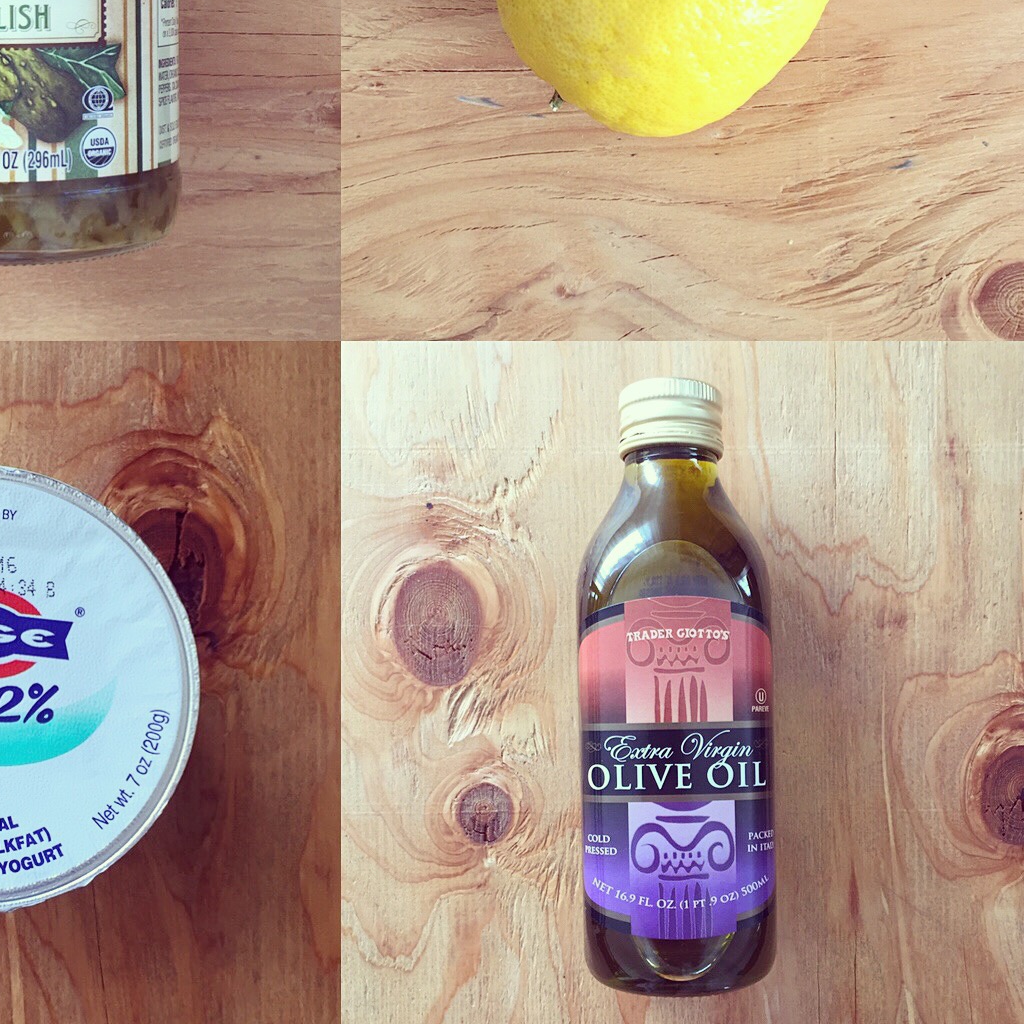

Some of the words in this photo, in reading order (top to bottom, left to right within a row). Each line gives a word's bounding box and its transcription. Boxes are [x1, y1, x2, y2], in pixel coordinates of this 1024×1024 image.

[90, 137, 109, 147] USDA
[2, 150, 19, 169] OZ
[23, 148, 73, 172] (296mL)
[1, 508, 18, 521] BY
[626, 628, 673, 643] TRADER
[676, 627, 731, 642] GIOTTO'S
[751, 705, 769, 713] PAREVE
[141, 709, 172, 756] (200g)
[604, 735, 674, 762] Extra
[680, 729, 754, 768] Virgin
[137, 758, 154, 777] oz
[587, 763, 692, 791] OLIVE
[706, 761, 767, 789] OIL
[127, 773, 143, 788] 7
[114, 788, 136, 812] wt.
[92, 806, 119, 831] Net
[587, 834, 611, 843] COLD
[585, 845, 617, 856] PRESSED
[747, 844, 758, 853] IN
[592, 877, 614, 895] NET
[615, 888, 637, 904] 16.9
[638, 896, 653, 908] FL.
[656, 899, 677, 909] OZ.
[679, 900, 690, 910] (1
[692, 899, 706, 908] PT
[708, 896, 718, 906] .9
[720, 890, 740, 904] OZ)
[741, 874, 770, 898] 500ML
